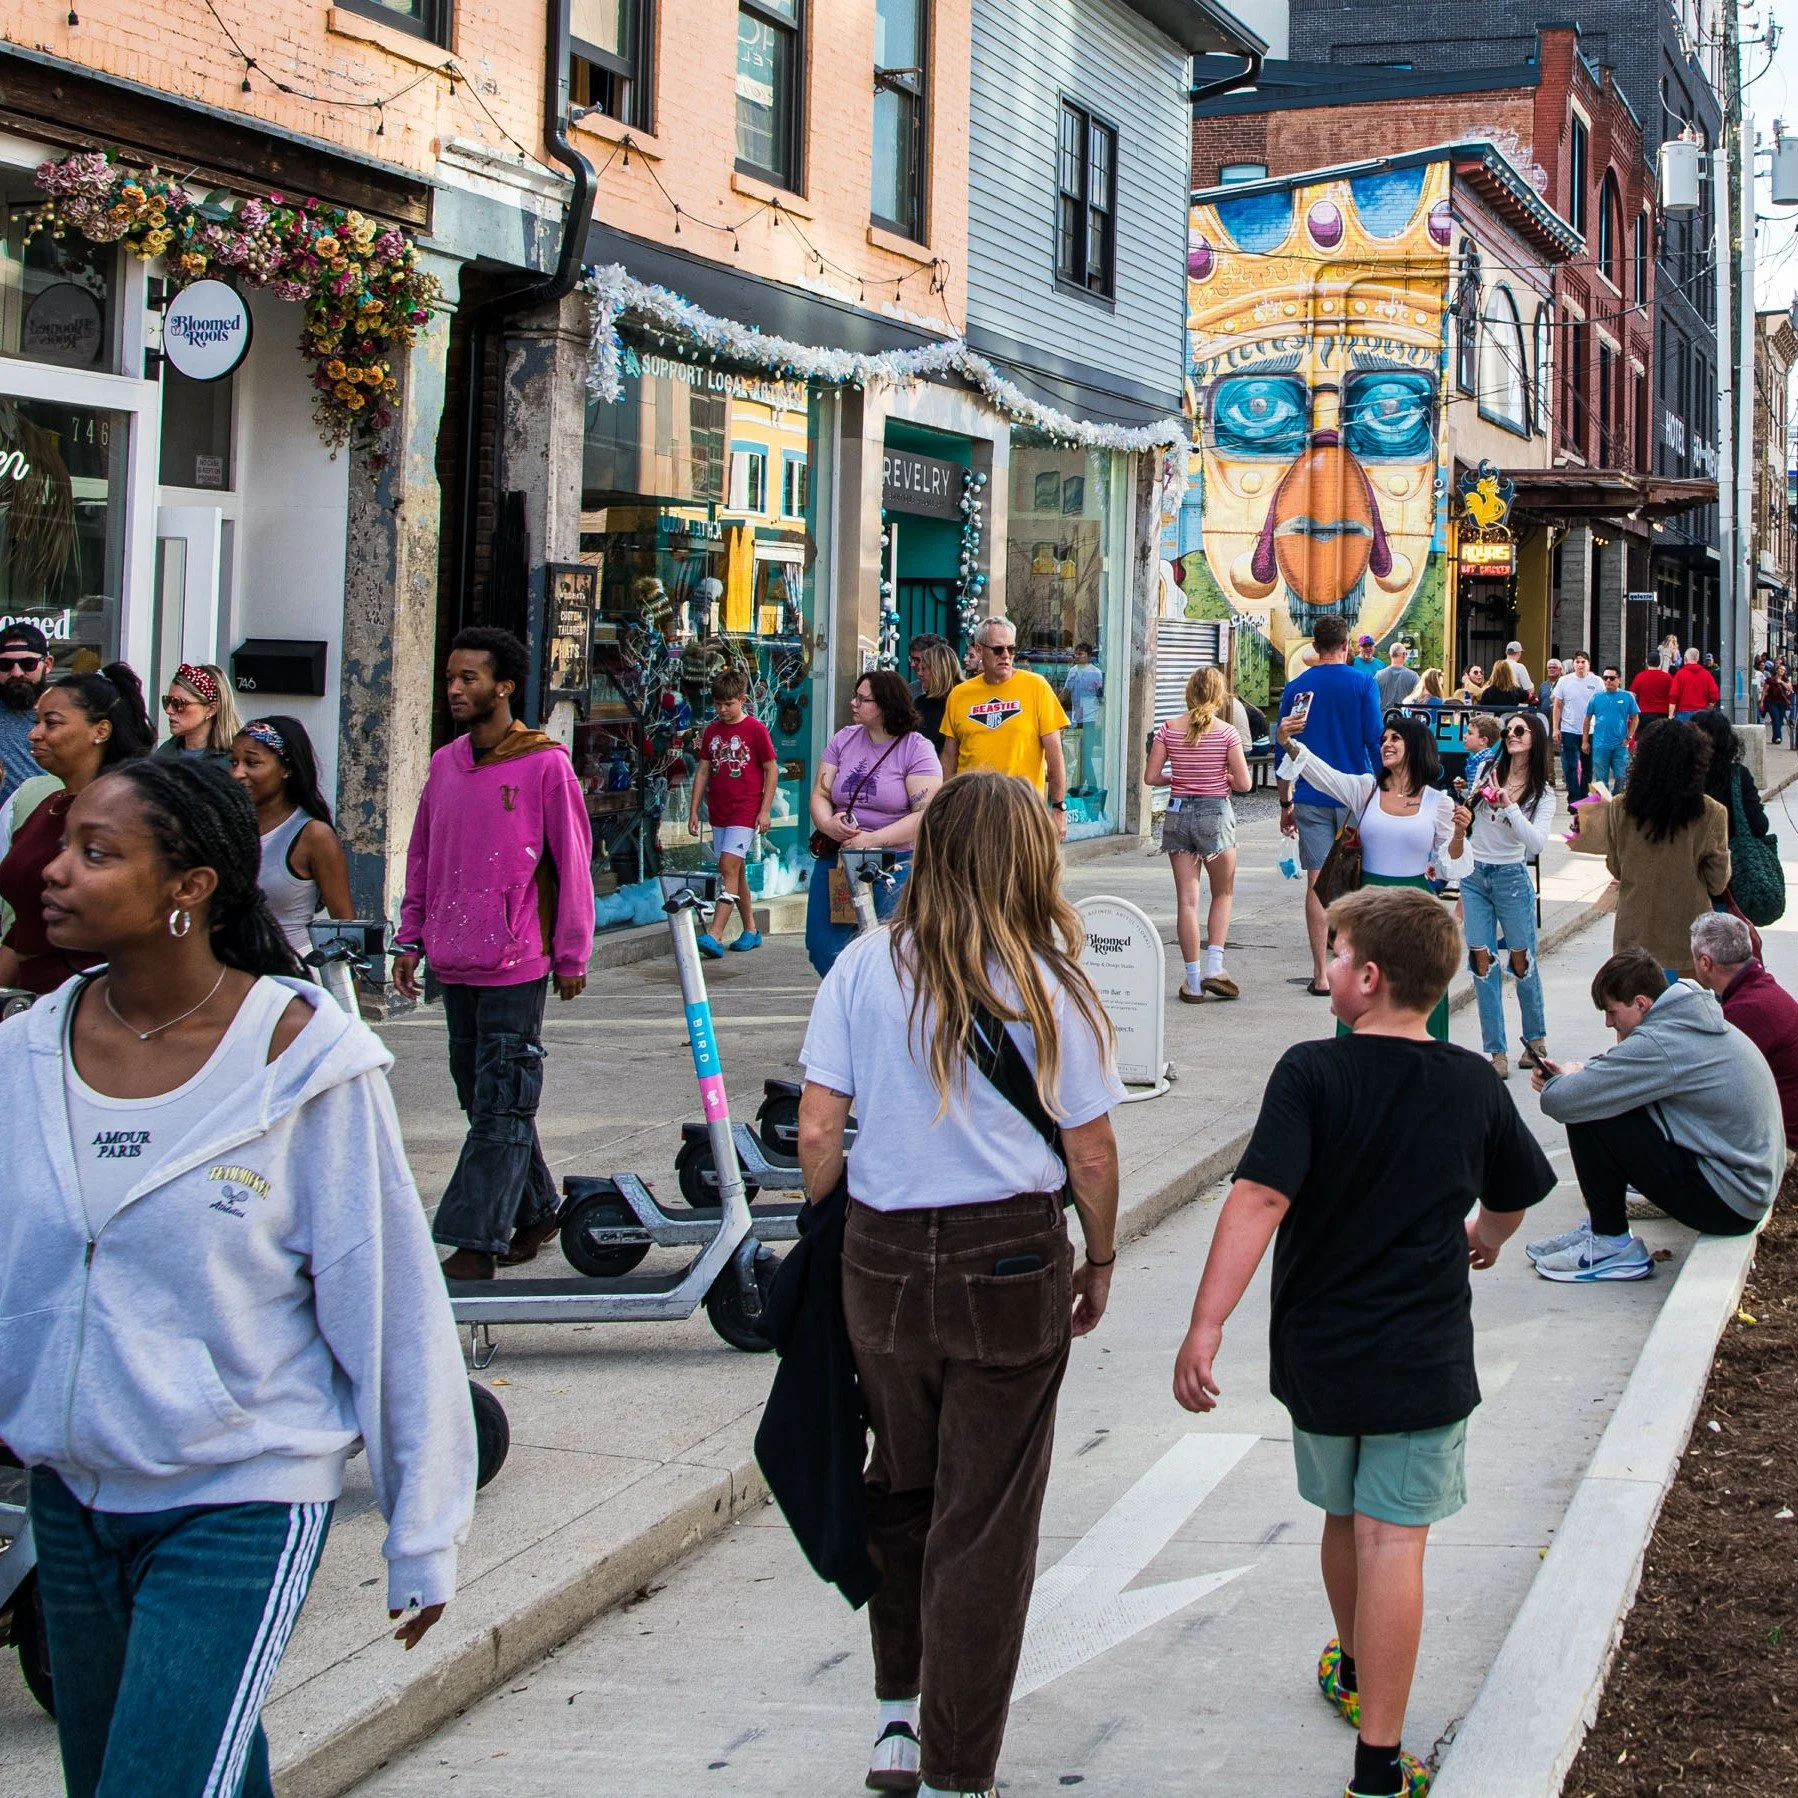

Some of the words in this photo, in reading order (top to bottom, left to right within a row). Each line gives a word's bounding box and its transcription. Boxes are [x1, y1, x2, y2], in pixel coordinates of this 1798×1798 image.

[171, 314, 241, 336] Bloomed
[184, 330, 229, 349] Roots
[641, 354, 703, 387] SUPPORT
[708, 370, 747, 399] LOCAL
[72, 417, 110, 447] 746
[1665, 410, 1685, 457] HOTEL
[883, 456, 950, 496] REVELRY
[560, 610, 583, 621] CUSTOM
[559, 643, 580, 659] HATS
[236, 677, 256, 690] 746
[972, 701, 1018, 714] BEASTIE
[986, 711, 1003, 728] BOYS
[1086, 933, 1131, 947] Bloomed
[1092, 944, 1123, 956] Roots
[693, 1018, 709, 1062] BIRD
[91, 1131, 151, 1145] AMOUR
[97, 1145, 141, 1158] PARIS
